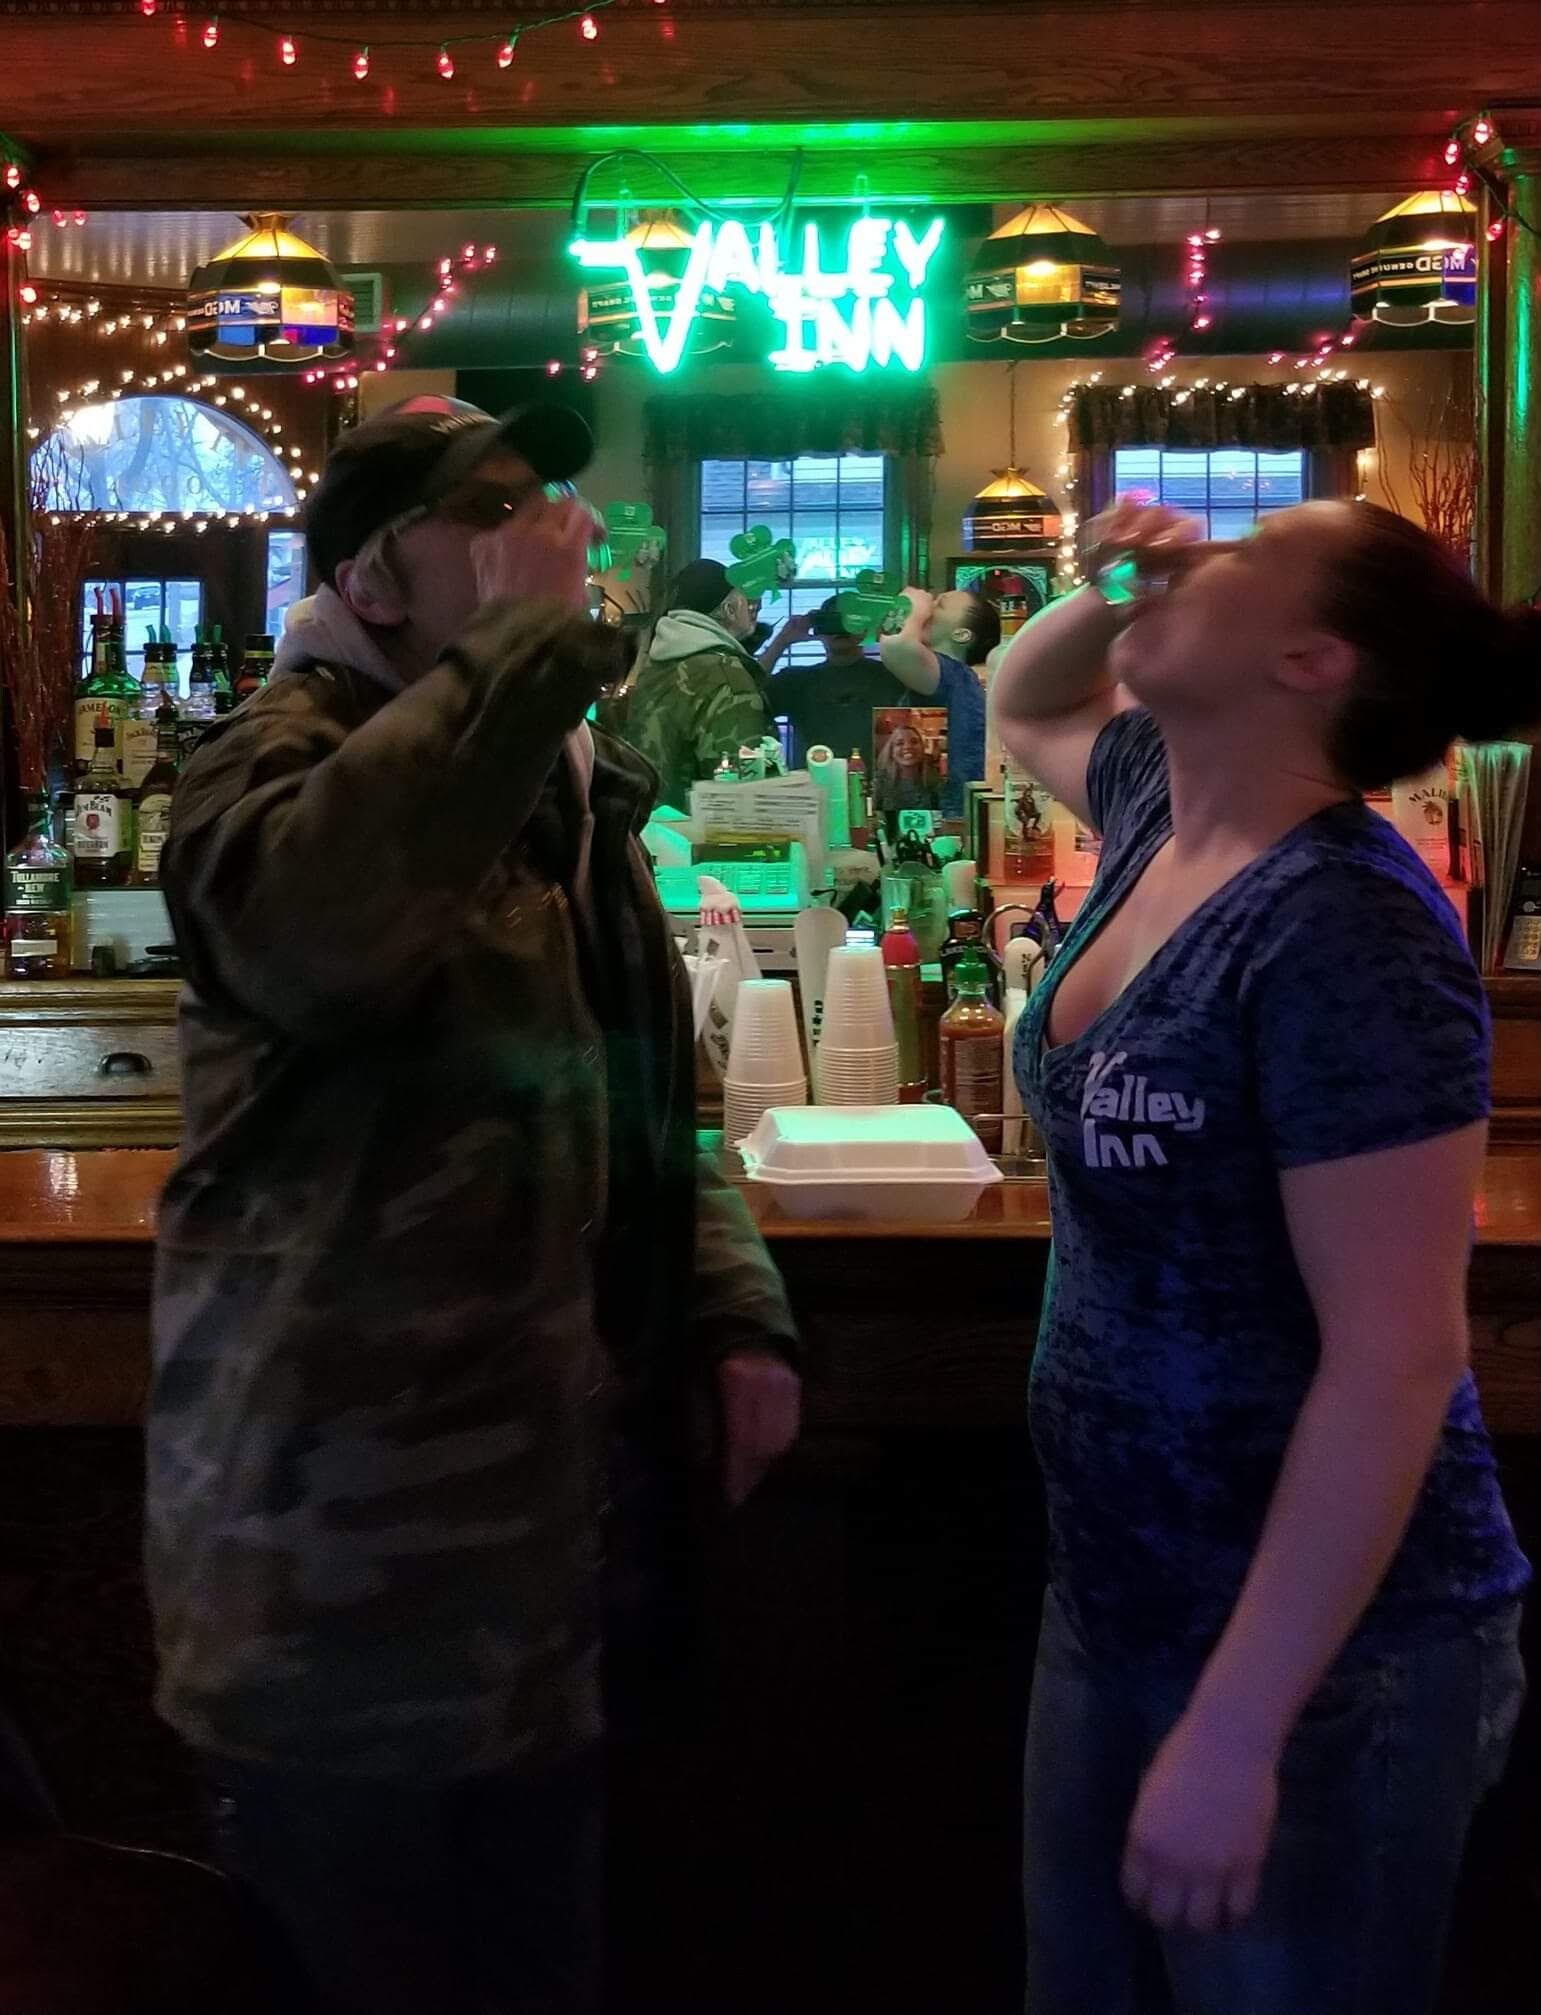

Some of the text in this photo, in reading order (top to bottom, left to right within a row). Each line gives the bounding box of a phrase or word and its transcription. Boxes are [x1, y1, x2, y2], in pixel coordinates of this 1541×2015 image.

[570, 216, 946, 374] VALLEY
[769, 296, 925, 371] INN
[79, 702, 121, 717] JAMEON
[1408, 787, 1449, 806] MALIB
[1080, 1051, 1205, 1131] Valley
[1083, 1118, 1168, 1168] Inn
